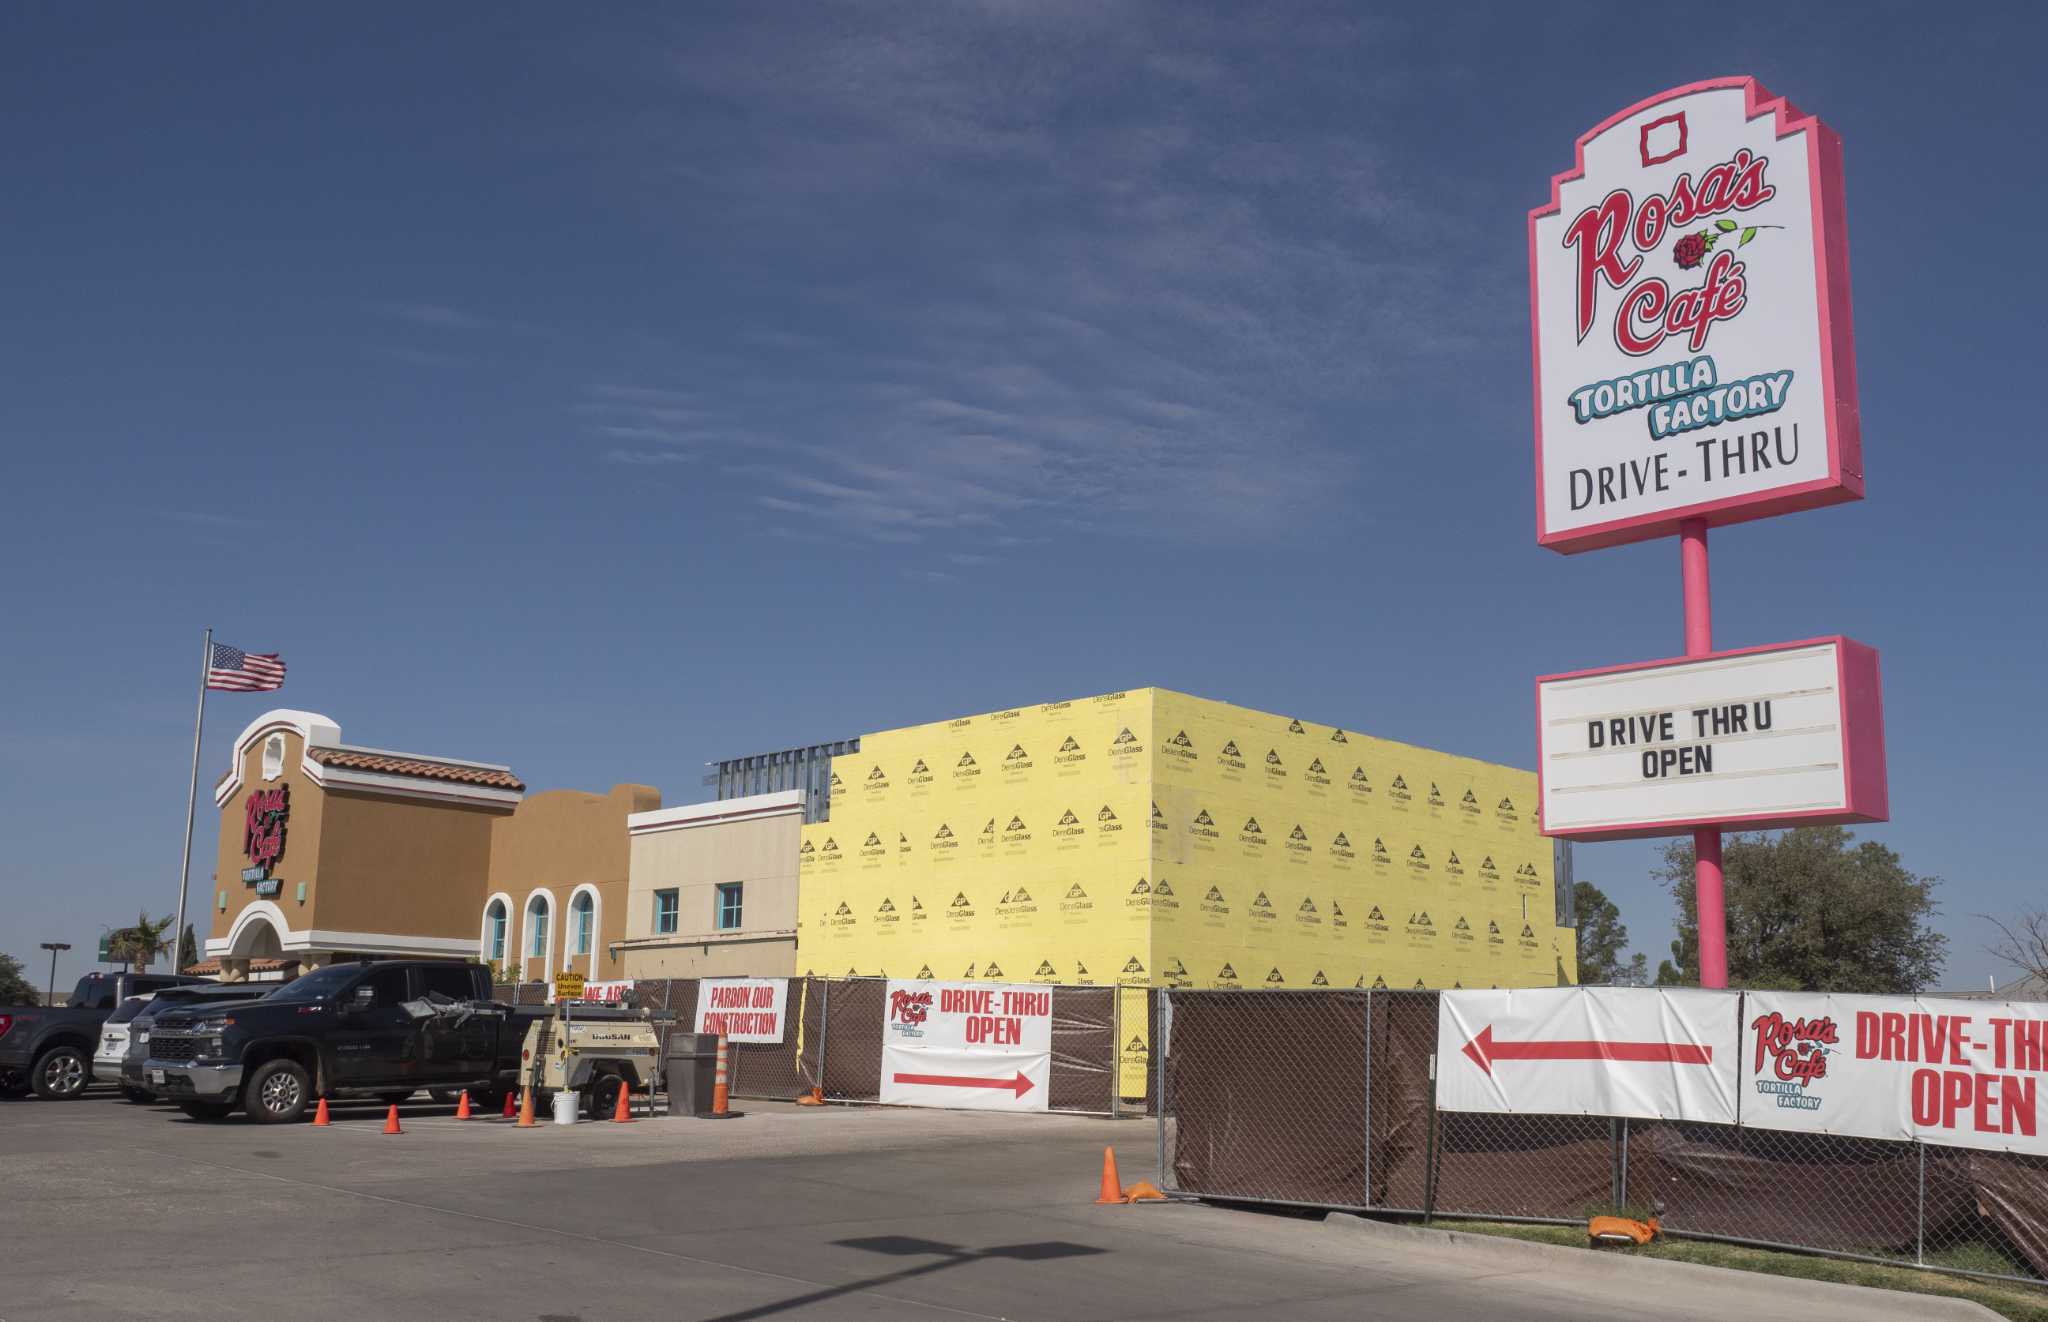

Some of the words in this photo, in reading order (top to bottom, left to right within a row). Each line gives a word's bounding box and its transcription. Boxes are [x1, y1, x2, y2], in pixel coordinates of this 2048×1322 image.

[1563, 149, 1775, 346] Rosa's
[1614, 250, 1747, 357] Café
[1570, 356, 1716, 423] TORTILLA
[1650, 371, 1793, 438] FACTORY
[1589, 713, 1674, 749] DRIVE
[1693, 701, 1771, 737] THRU
[1119, 733, 1131, 742] GP
[1177, 737, 1188, 745] GP
[1108, 746, 1143, 756] DensGlass
[962, 757, 972, 766] GP
[1643, 745, 1712, 778] OPEN
[1063, 816, 1074, 824] GP
[1100, 812, 1111, 820] GP
[1011, 822, 1021, 830] GP
[1001, 834, 1031, 843] DensGlass
[1053, 829, 1084, 837] DensGlass
[1136, 885, 1148, 893] GP
[955, 898, 966, 906] GP
[947, 910, 975, 918] DensGlass
[988, 968, 998, 976] GP
[1128, 963, 1139, 971] GP
[585, 987, 602, 1000] WE
[711, 987, 751, 1008] PARDON
[752, 987, 774, 1008] OUR
[941, 989, 1049, 1016] DRIVE-THRU
[703, 1012, 777, 1034] CONSTRUCTION
[966, 1016, 1021, 1045] OPEN
[1131, 1041, 1142, 1049] GP
[1752, 1012, 1840, 1075] Rosa's
[1856, 1011, 2048, 1072] DRIVE-TH
[1775, 1049, 1826, 1087] Café
[1756, 1081, 1802, 1095] TORTILLA
[1777, 1095, 1821, 1110] FACTORY
[1912, 1069, 2036, 1136] OPEN
